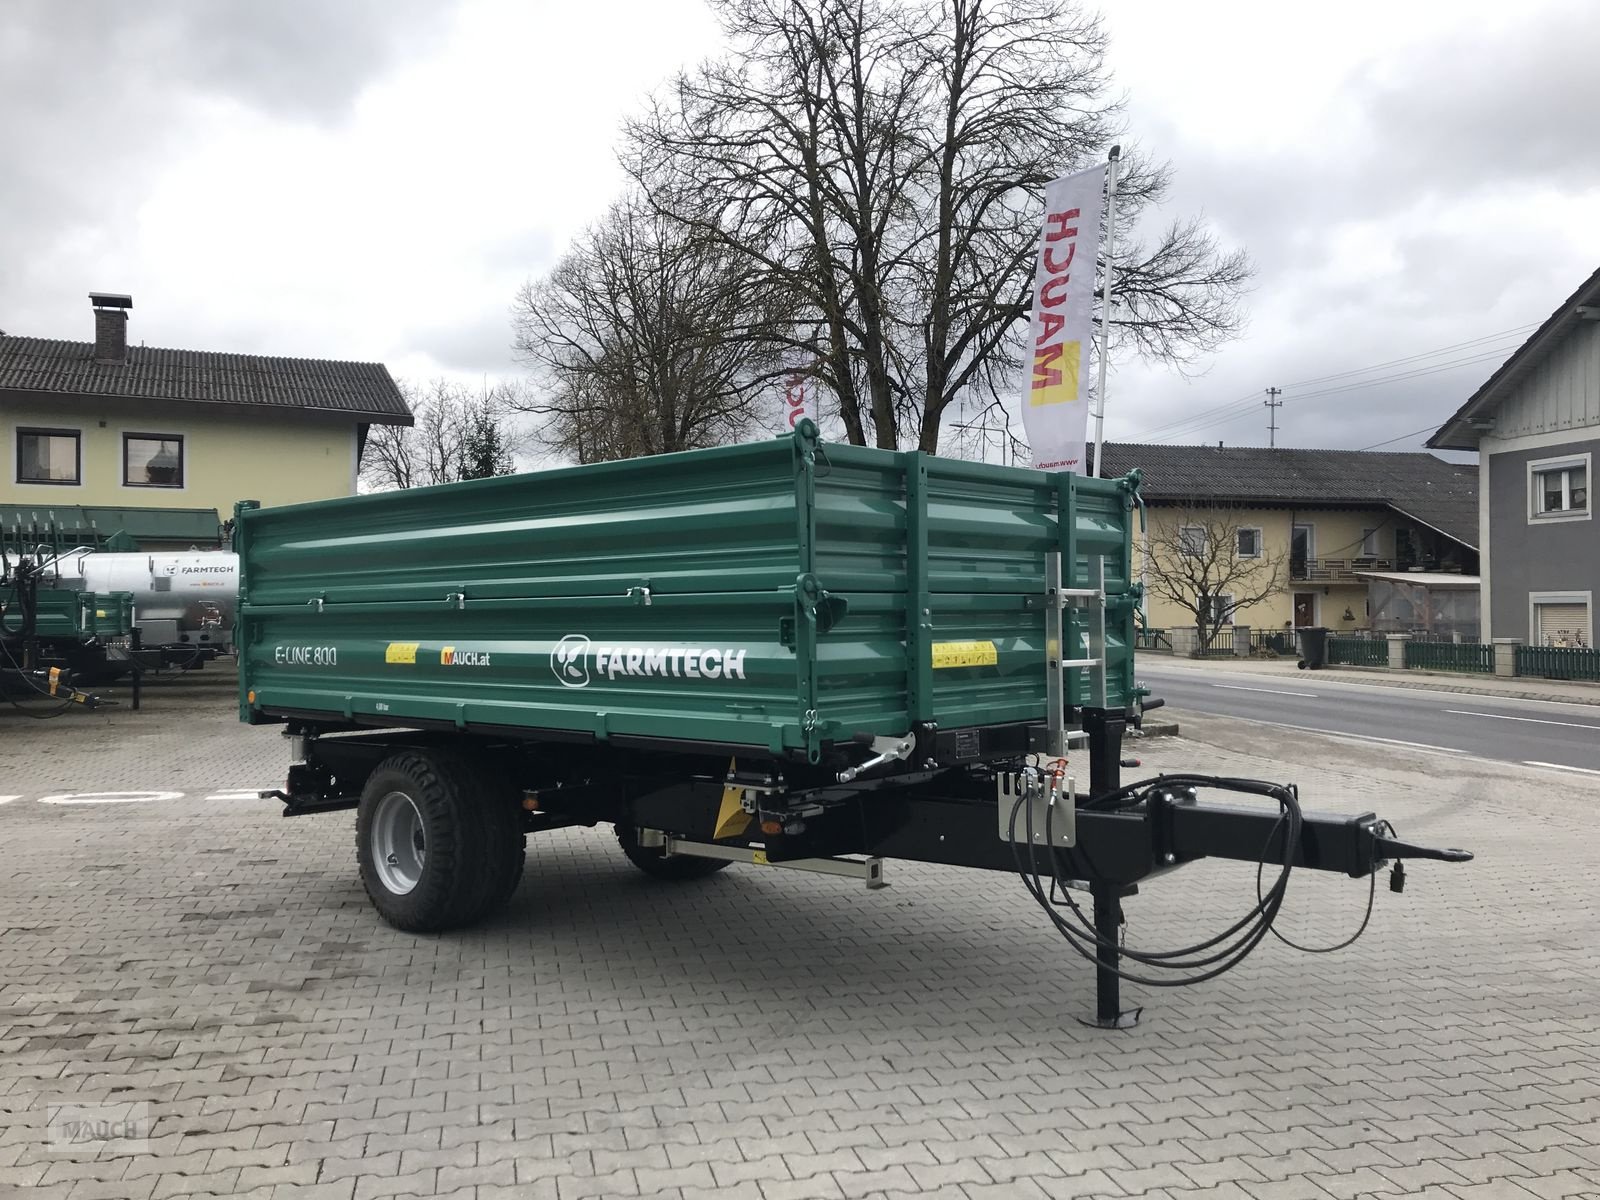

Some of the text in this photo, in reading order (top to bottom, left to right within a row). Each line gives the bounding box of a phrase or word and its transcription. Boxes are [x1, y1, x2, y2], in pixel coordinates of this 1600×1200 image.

[181, 566, 234, 575] FARMTECH
[313, 647, 337, 666] 800
[444, 651, 491, 667] MAUCH.at
[596, 648, 747, 681] FARMTECH
